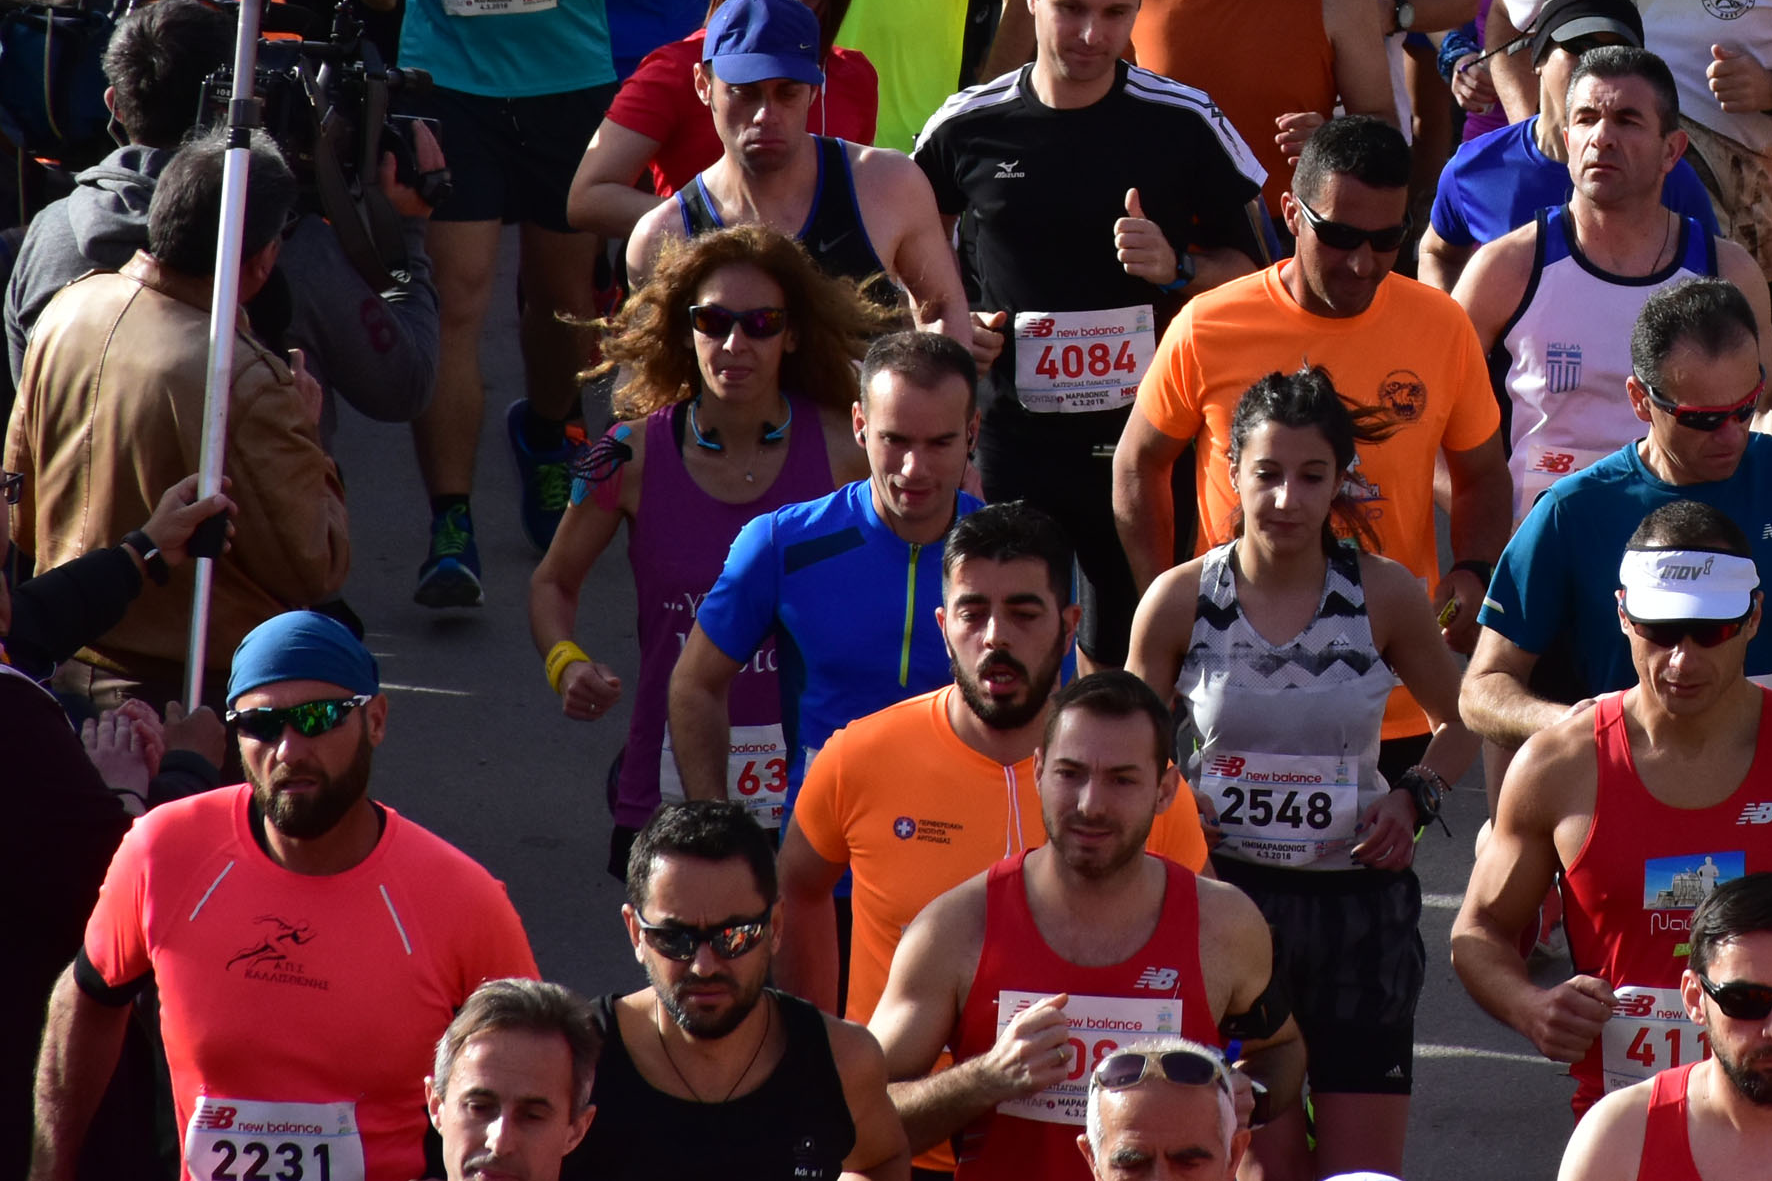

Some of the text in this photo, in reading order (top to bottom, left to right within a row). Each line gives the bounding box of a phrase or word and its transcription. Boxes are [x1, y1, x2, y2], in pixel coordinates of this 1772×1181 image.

[1057, 328, 1079, 338] new
[1081, 325, 1126, 337] balance
[1035, 340, 1137, 380] 4084
[1066, 390, 1110, 400] ΜΑΡΑΘΩΝΙΟΣ
[1246, 772, 1270, 781] new
[1272, 771, 1322, 784] balance
[1219, 786, 1333, 830] 2548
[1242, 840, 1307, 852] ΗΜΙΜΑΡΑΘΩΝΙΟΣ
[1256, 850, 1292, 860] 4.3.2018
[1656, 1009, 1683, 1020] new
[1086, 1016, 1143, 1032] balance
[238, 1122, 264, 1133] new
[267, 1122, 323, 1134] balance
[211, 1139, 331, 1181] 2231
